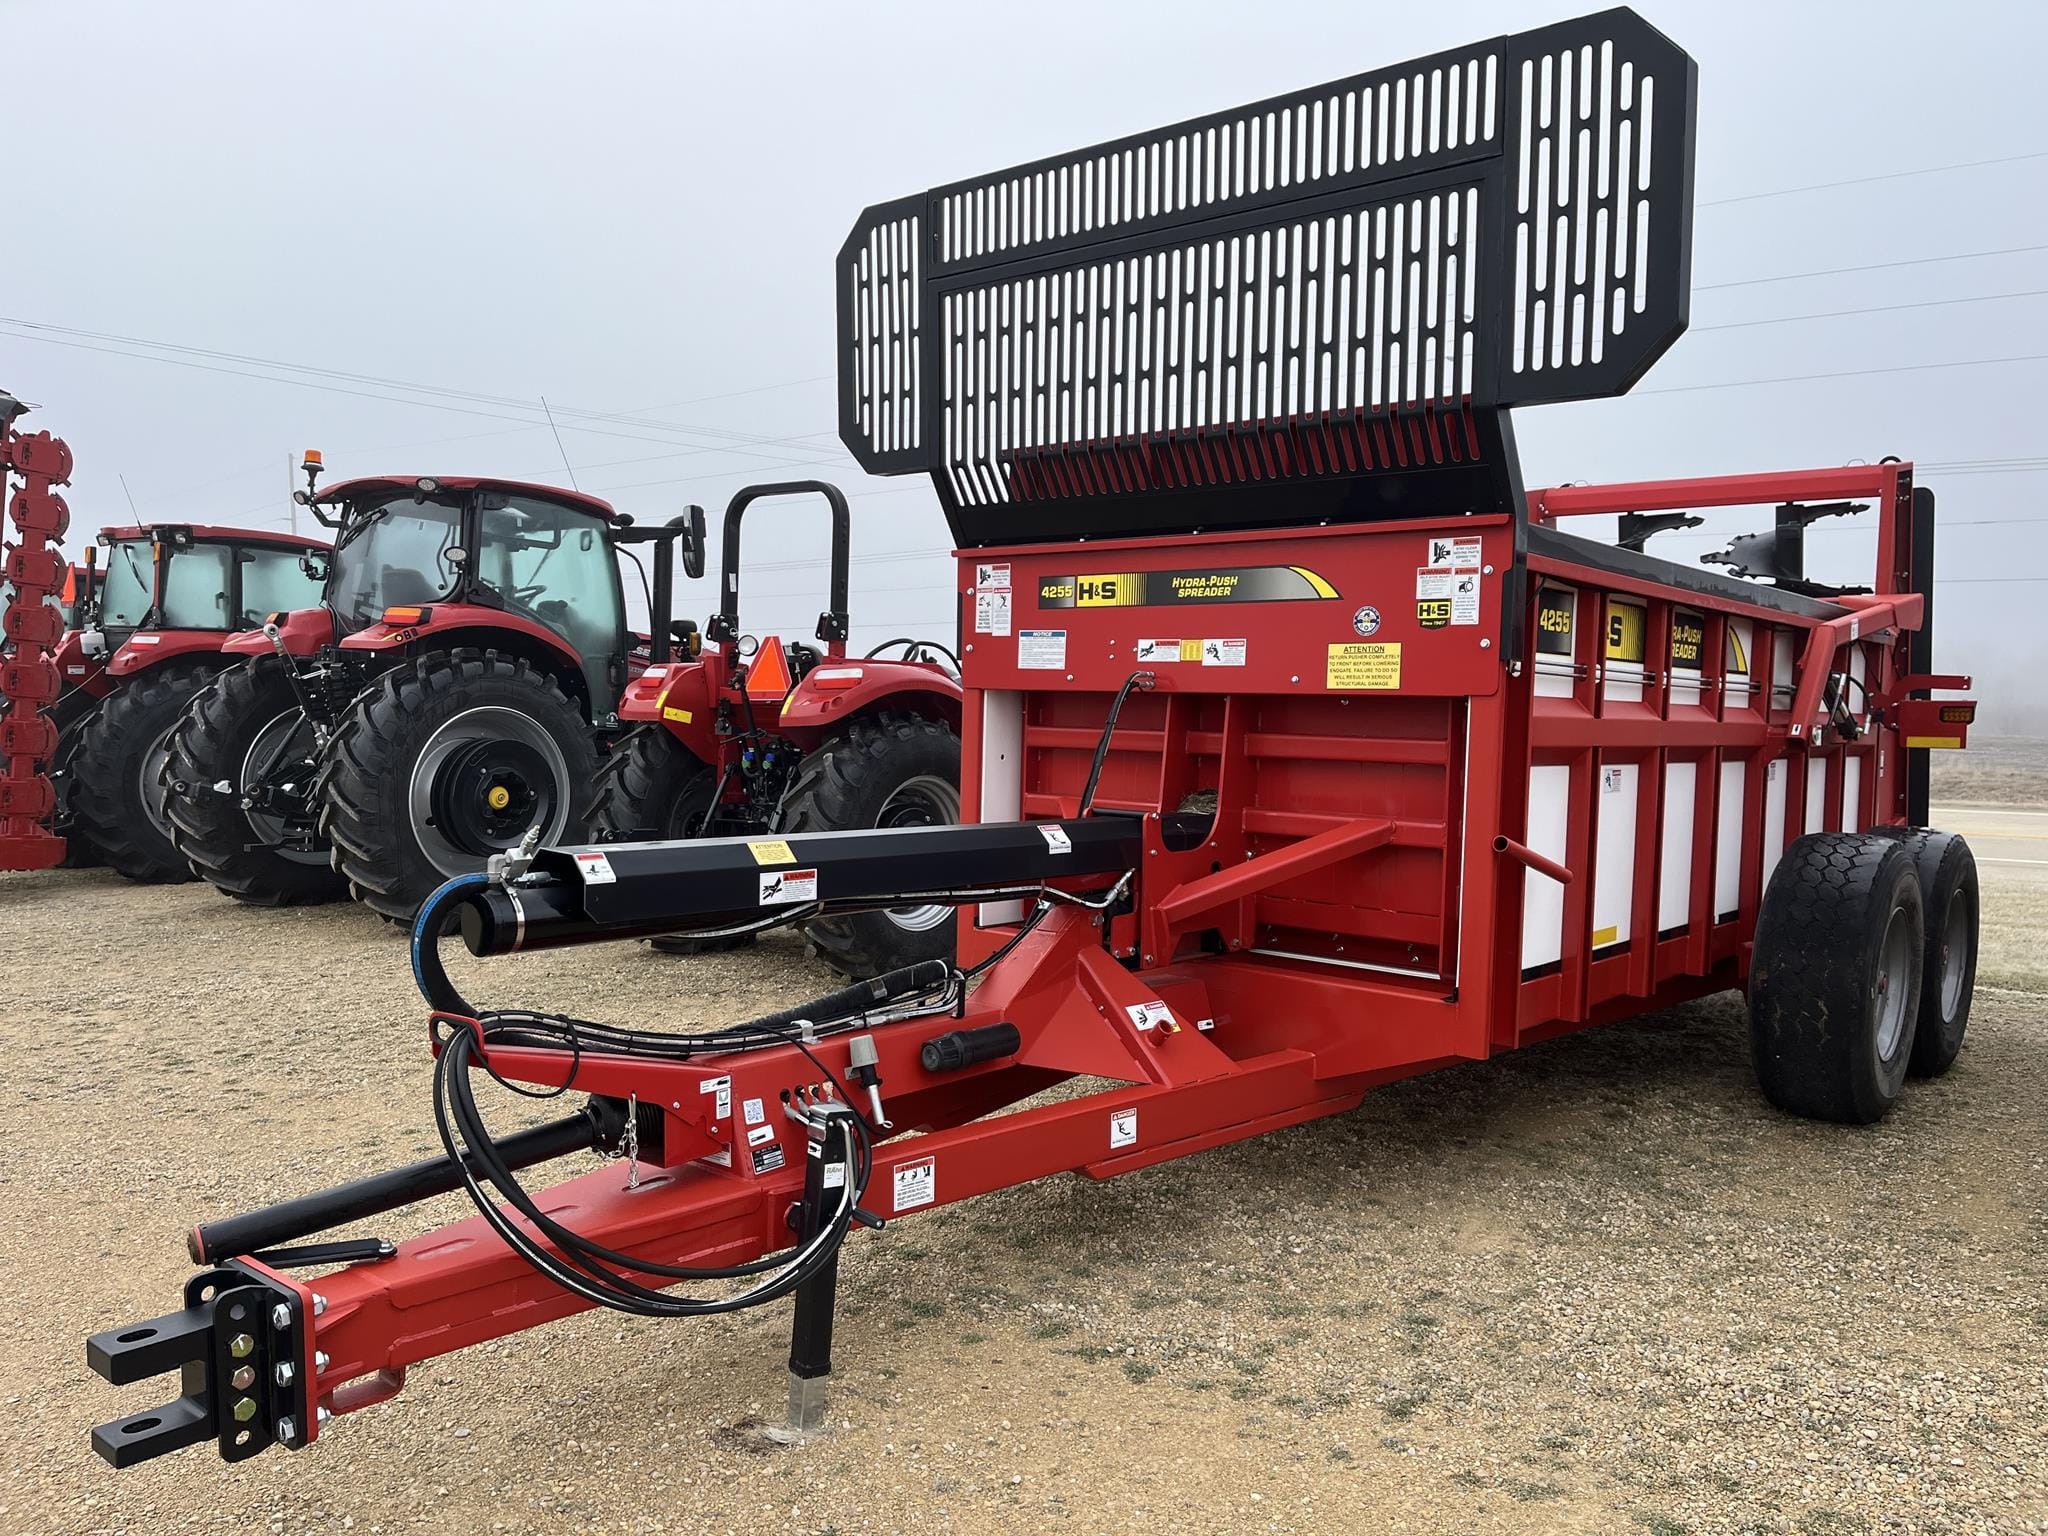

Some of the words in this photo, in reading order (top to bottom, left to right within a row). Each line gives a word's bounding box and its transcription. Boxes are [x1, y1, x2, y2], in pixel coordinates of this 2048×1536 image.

[1172, 575, 1239, 588] HYDRA-PUSH
[1041, 586, 1073, 598] 4255
[1079, 581, 1117, 600] H&S
[1177, 587, 1231, 598] SPREADER
[1419, 603, 1449, 617] H&S
[1540, 608, 1570, 633] 4255
[1343, 646, 1385, 654] ATTENTION
[789, 870, 815, 880] WARNING
